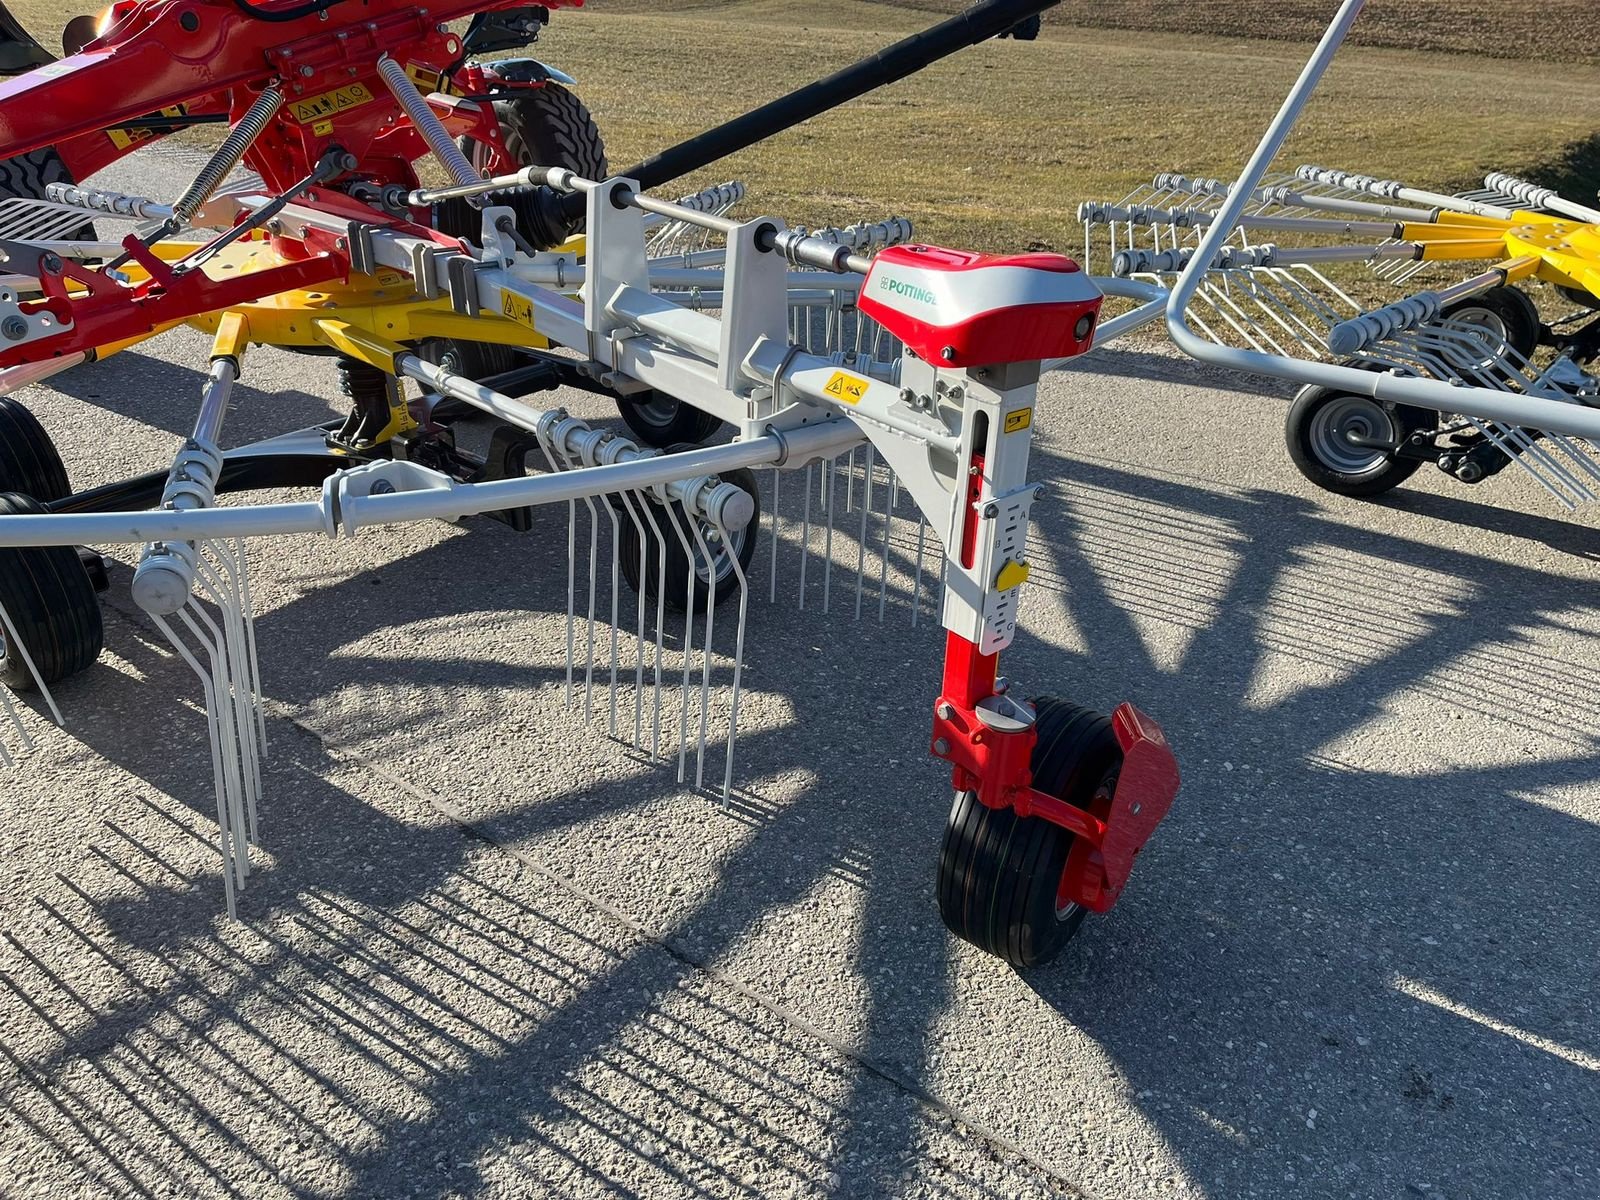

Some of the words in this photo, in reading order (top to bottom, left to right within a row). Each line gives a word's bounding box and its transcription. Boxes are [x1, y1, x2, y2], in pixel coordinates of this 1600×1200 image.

[1020, 511, 1026, 519] A
[1015, 550, 1022, 560] C
[1010, 588, 1017, 598] E
[986, 614, 992, 624] F
